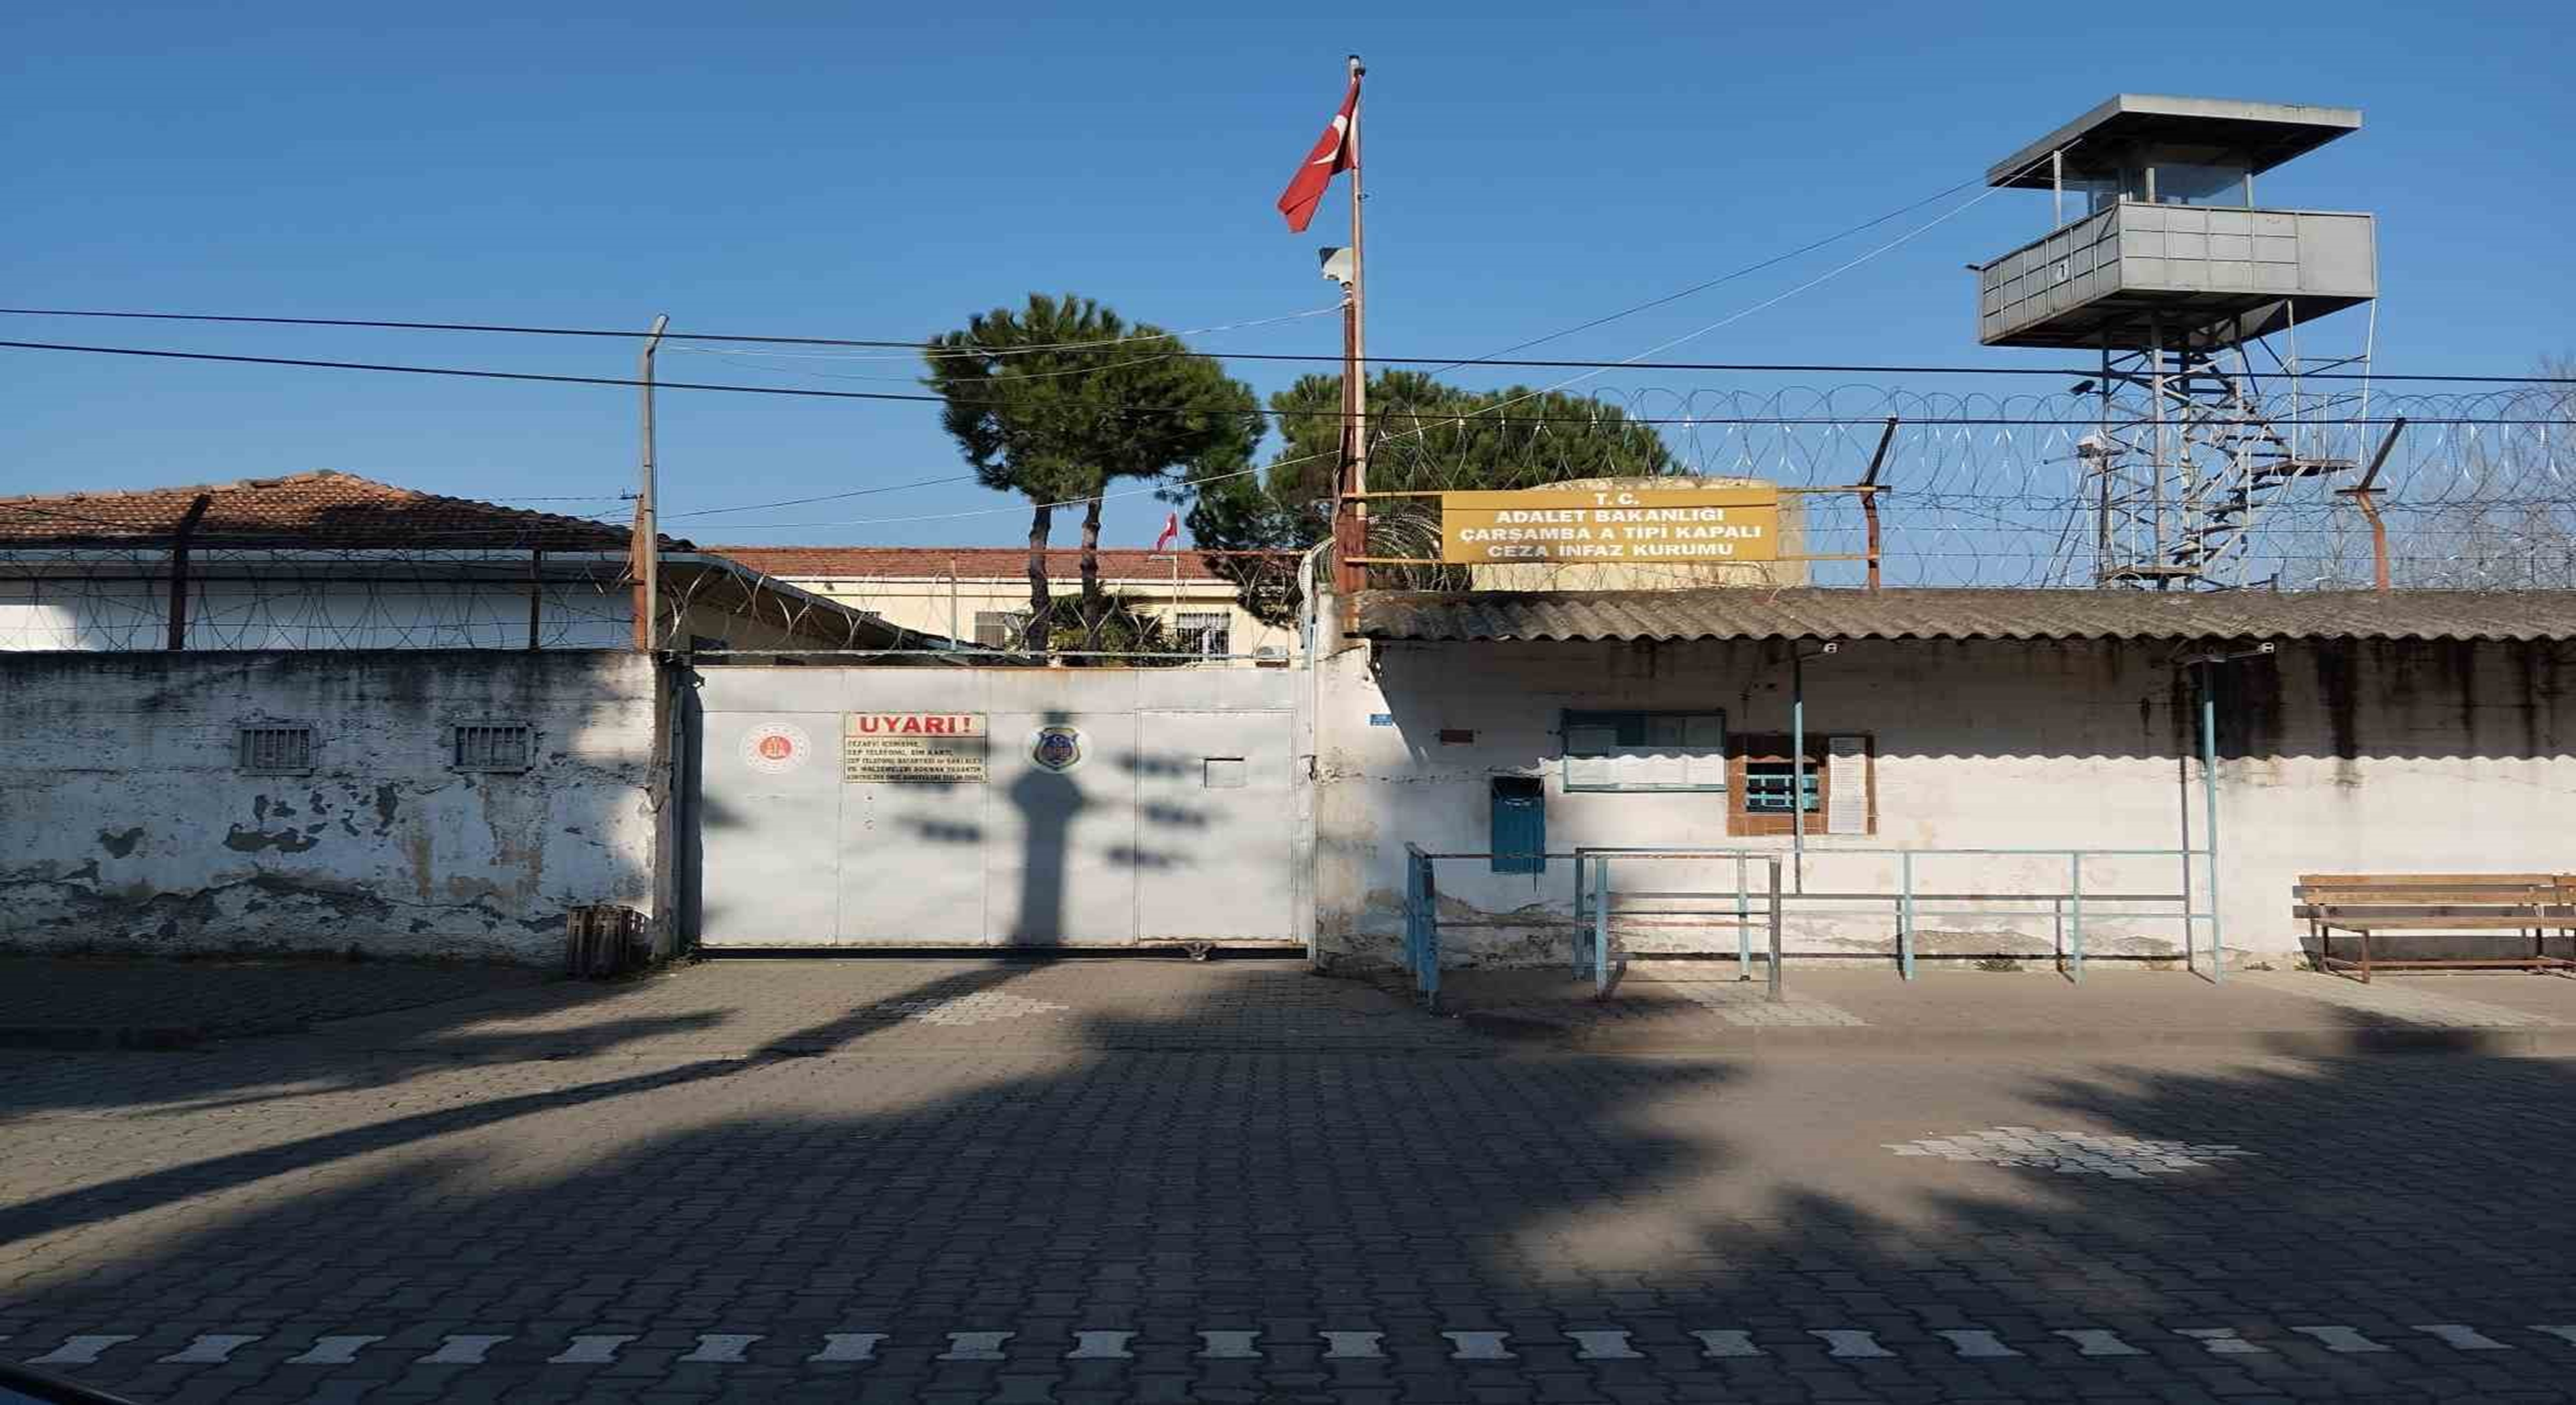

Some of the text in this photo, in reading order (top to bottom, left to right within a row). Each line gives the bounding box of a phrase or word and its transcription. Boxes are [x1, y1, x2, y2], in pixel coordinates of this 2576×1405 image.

[1495, 507, 1725, 524] ADALET BAKANLIĞI
[1460, 524, 1763, 543] ÇARŞAMBA A TİPİ KAPALI
[1487, 542, 1734, 558] CEZA İNFAZ KURUMU
